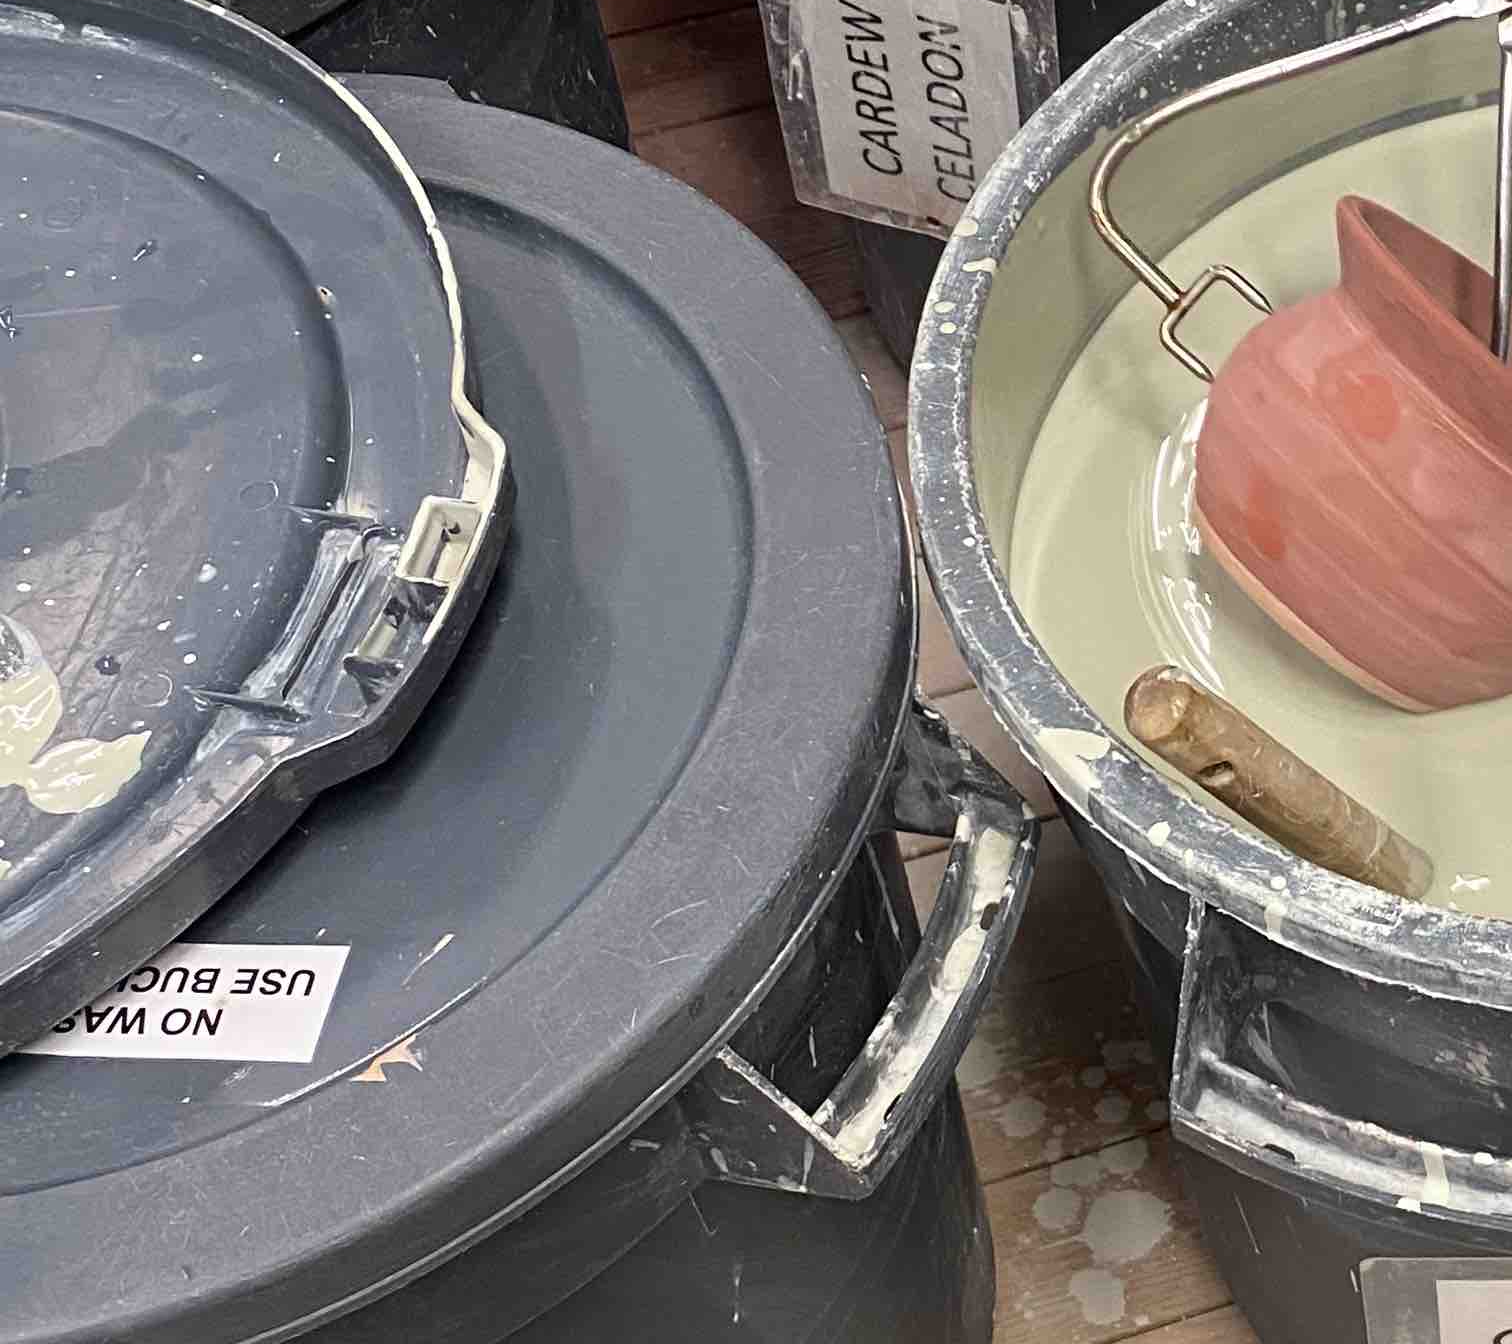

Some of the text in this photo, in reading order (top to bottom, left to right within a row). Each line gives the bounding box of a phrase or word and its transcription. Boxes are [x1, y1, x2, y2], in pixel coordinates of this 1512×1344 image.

[916, 15, 976, 203] CELADON
[116, 966, 316, 997] USE BUC
[160, 1008, 223, 1036] NO
